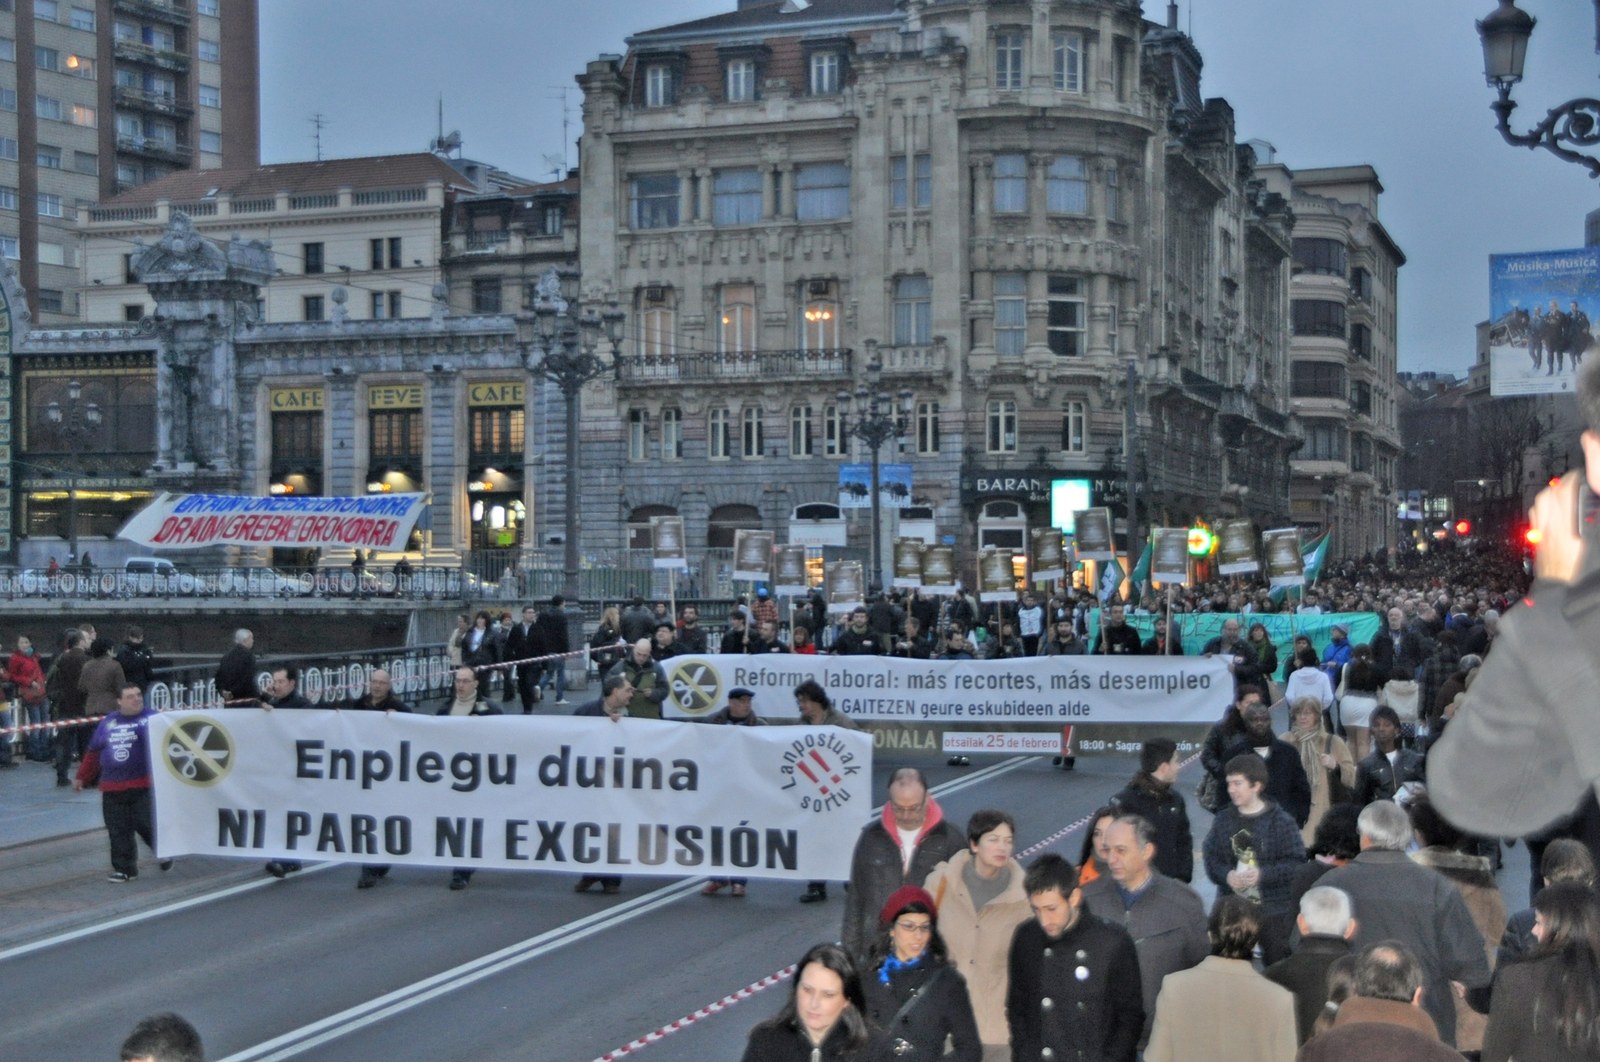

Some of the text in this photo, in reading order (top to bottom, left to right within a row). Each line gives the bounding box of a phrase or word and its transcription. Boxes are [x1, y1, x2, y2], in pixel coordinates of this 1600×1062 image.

[273, 391, 322, 407] CAFE
[371, 388, 421, 405] FEVE
[471, 385, 522, 402] CAFE
[734, 667, 1211, 694] Reforma laboral: más recortes, más desempleo
[842, 699, 915, 714] GAITEZEN
[921, 703, 963, 718] geure
[968, 701, 1053, 716] eskubideen
[1058, 701, 1090, 716] alde
[944, 734, 1059, 748] otsailak 25 de febrero
[1079, 740, 1105, 750] 18:00
[1115, 740, 1142, 752] Sagra
[295, 739, 699, 792] Enplegu duina
[781, 732, 861, 790] Lanpostuak
[800, 788, 851, 813] sortu
[218, 808, 798, 871] NI PARO NI EXCLUSIÓN
